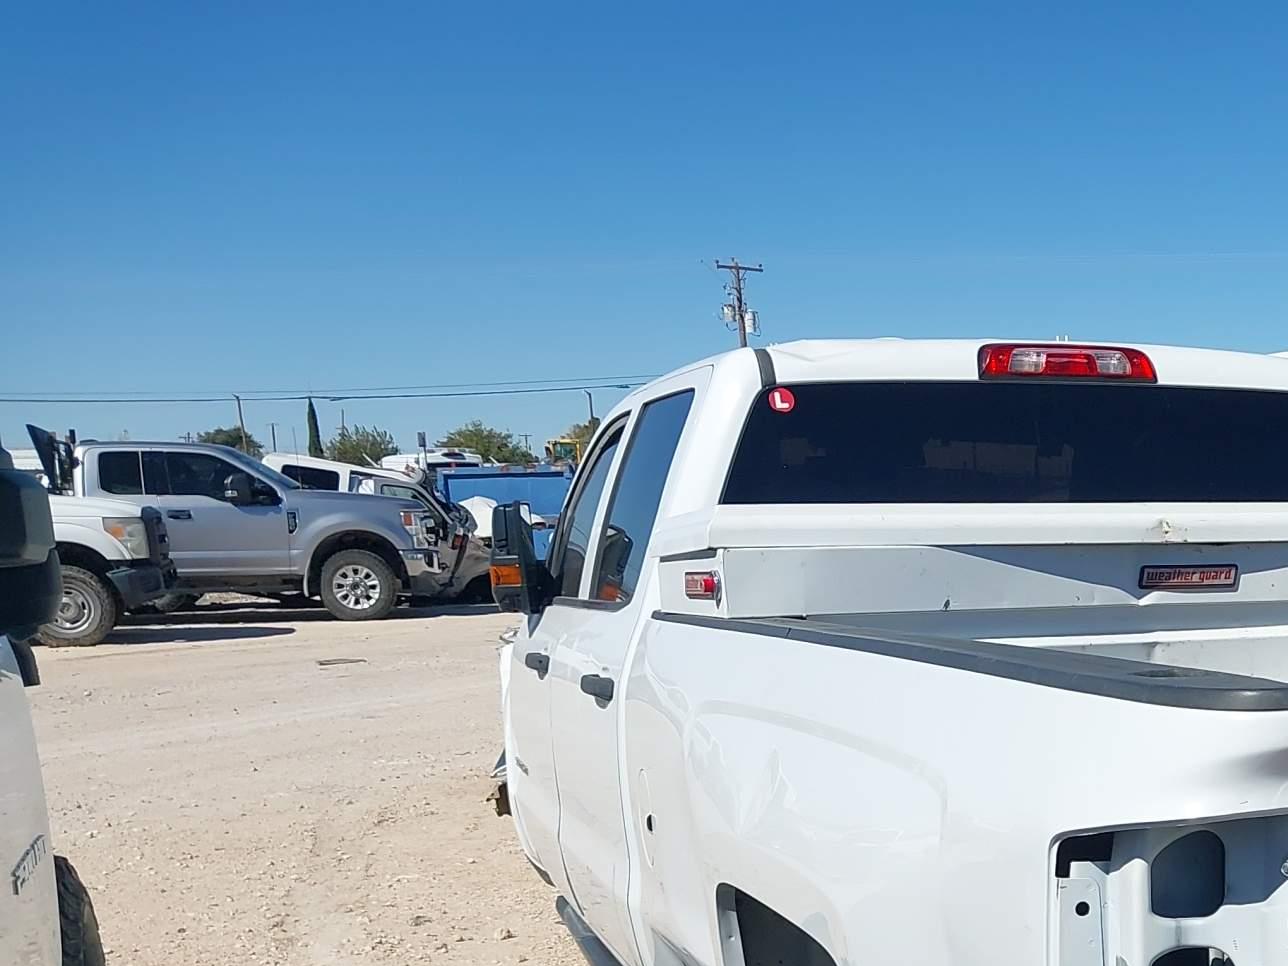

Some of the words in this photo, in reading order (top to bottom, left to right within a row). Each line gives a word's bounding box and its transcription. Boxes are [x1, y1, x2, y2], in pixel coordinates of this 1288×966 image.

[774, 391, 790, 409] L
[1146, 569, 1197, 581] weather
[1198, 568, 1233, 583] guard
